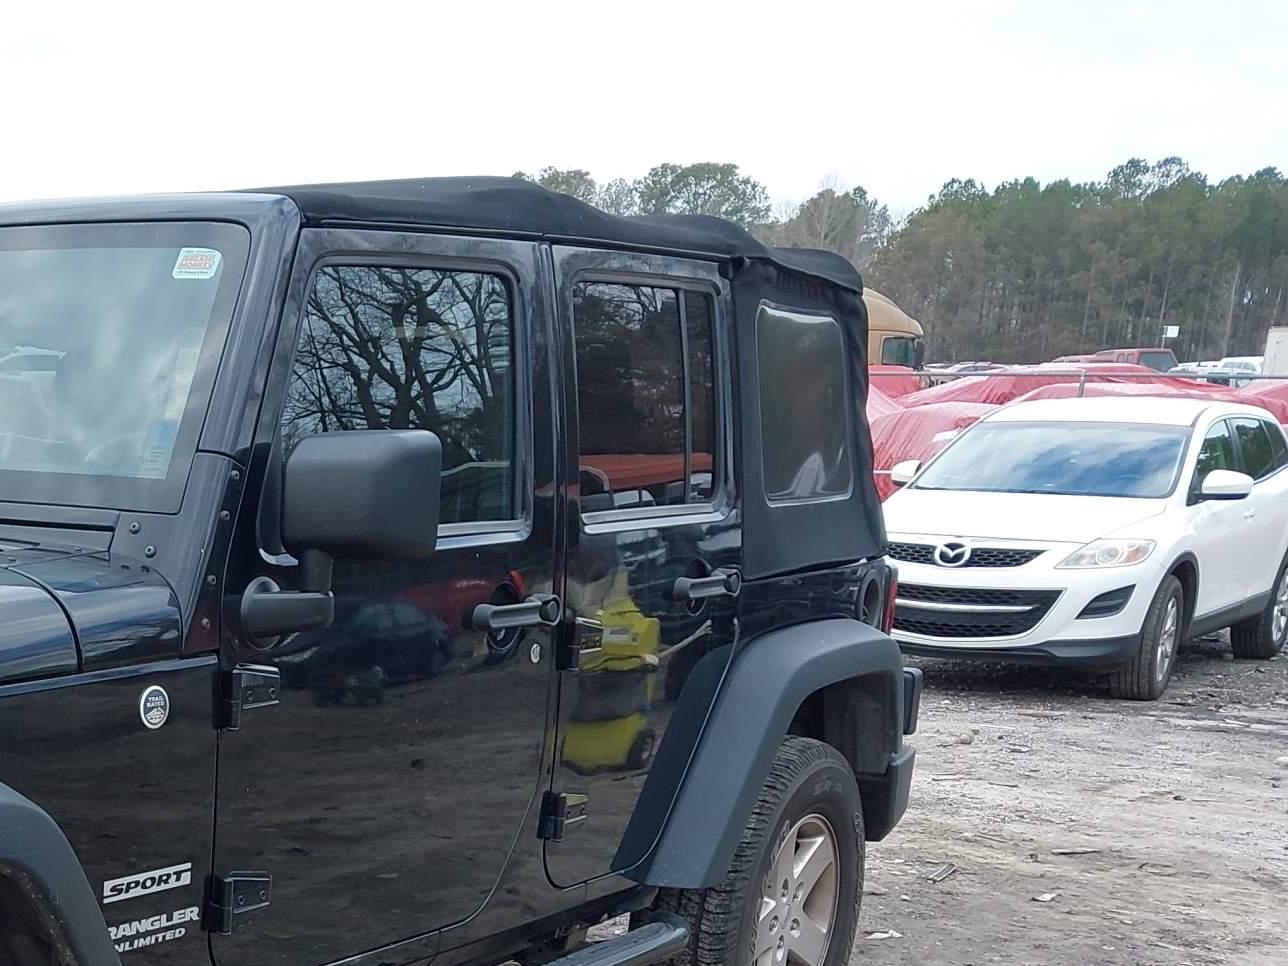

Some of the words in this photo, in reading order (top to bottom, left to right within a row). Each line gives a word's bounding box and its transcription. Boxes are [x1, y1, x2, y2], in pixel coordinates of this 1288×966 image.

[107, 868, 191, 899] SPORT
[107, 906, 200, 940] RANGLER
[114, 927, 186, 953] NLIMITED
